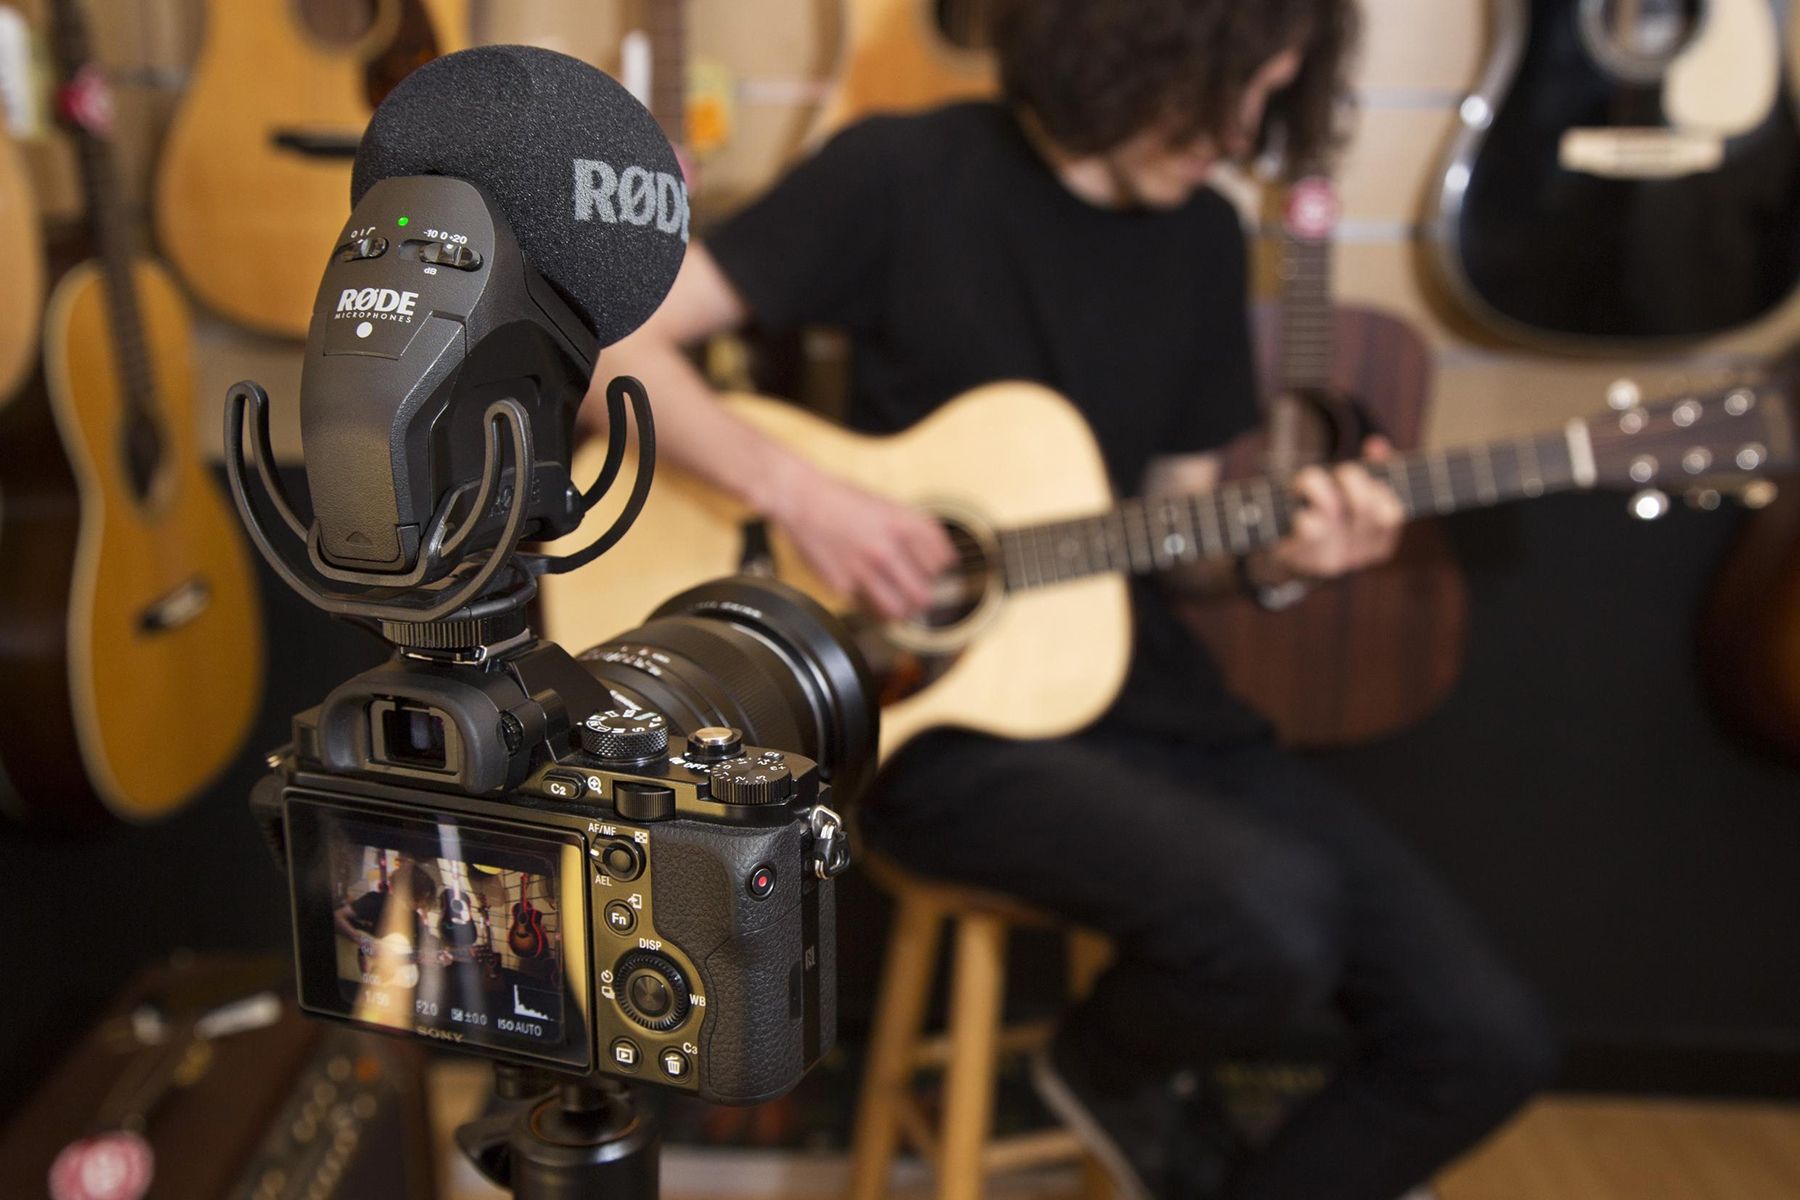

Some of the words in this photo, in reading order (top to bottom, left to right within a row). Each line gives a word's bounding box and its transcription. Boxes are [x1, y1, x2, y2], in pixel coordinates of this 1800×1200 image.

[423, 267, 438, 276] dB
[337, 287, 419, 316] RØDE
[334, 311, 412, 324] MICROPHONES
[551, 783, 567, 796] C2
[588, 822, 617, 836] AF/MF
[595, 875, 612, 887] AEL
[611, 912, 627, 926] Fn
[639, 938, 662, 951] DISP
[690, 993, 706, 1007] WB
[415, 1025, 464, 1042] SONY
[497, 1018, 514, 1031] ISO
[515, 1022, 543, 1037] AUTO
[682, 1042, 698, 1055] C3
